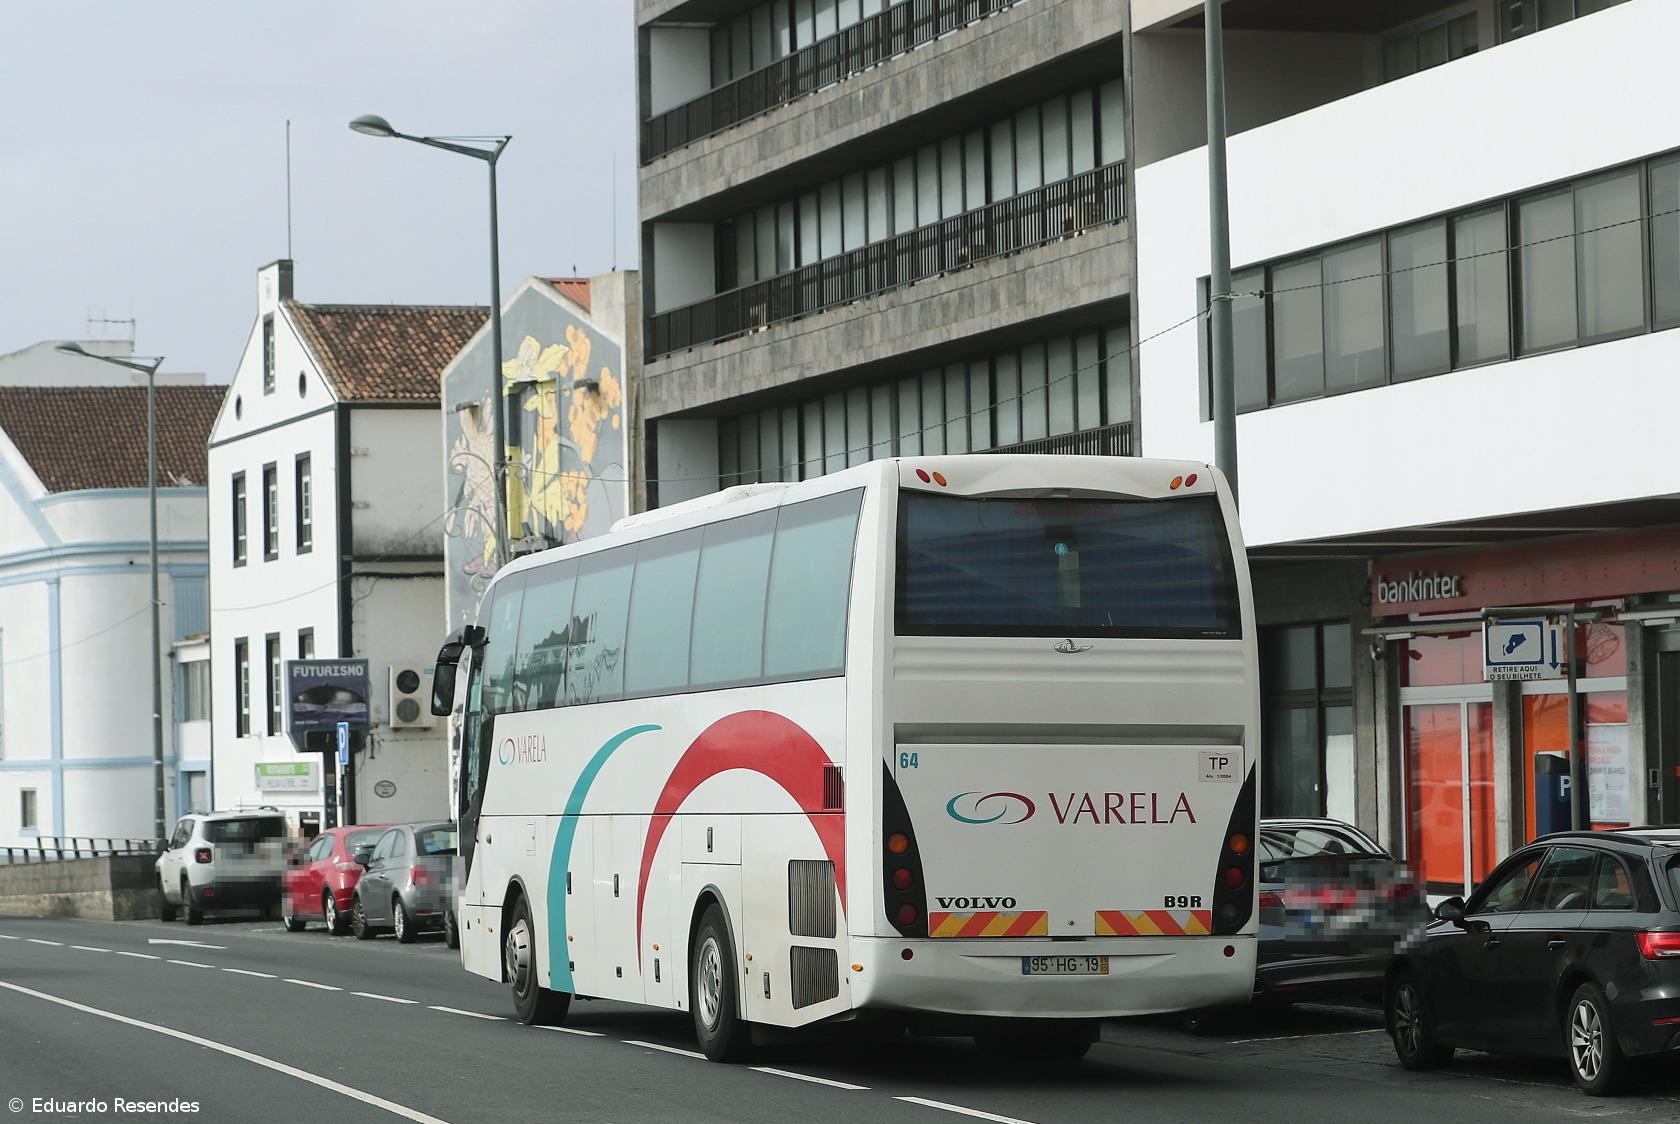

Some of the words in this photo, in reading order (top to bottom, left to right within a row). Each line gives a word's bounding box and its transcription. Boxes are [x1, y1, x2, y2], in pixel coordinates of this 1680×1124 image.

[293, 664, 364, 678] FUTURISMO
[1512, 672, 1542, 680] BILHETE
[338, 727, 346, 761] P
[517, 734, 547, 764] VARELA
[899, 751, 919, 770] 64
[1208, 757, 1229, 770] TP
[1560, 775, 1571, 797] P
[1047, 791, 1197, 825] VARELA
[935, 896, 1017, 910] VOLVO
[1164, 895, 1203, 908] B9R
